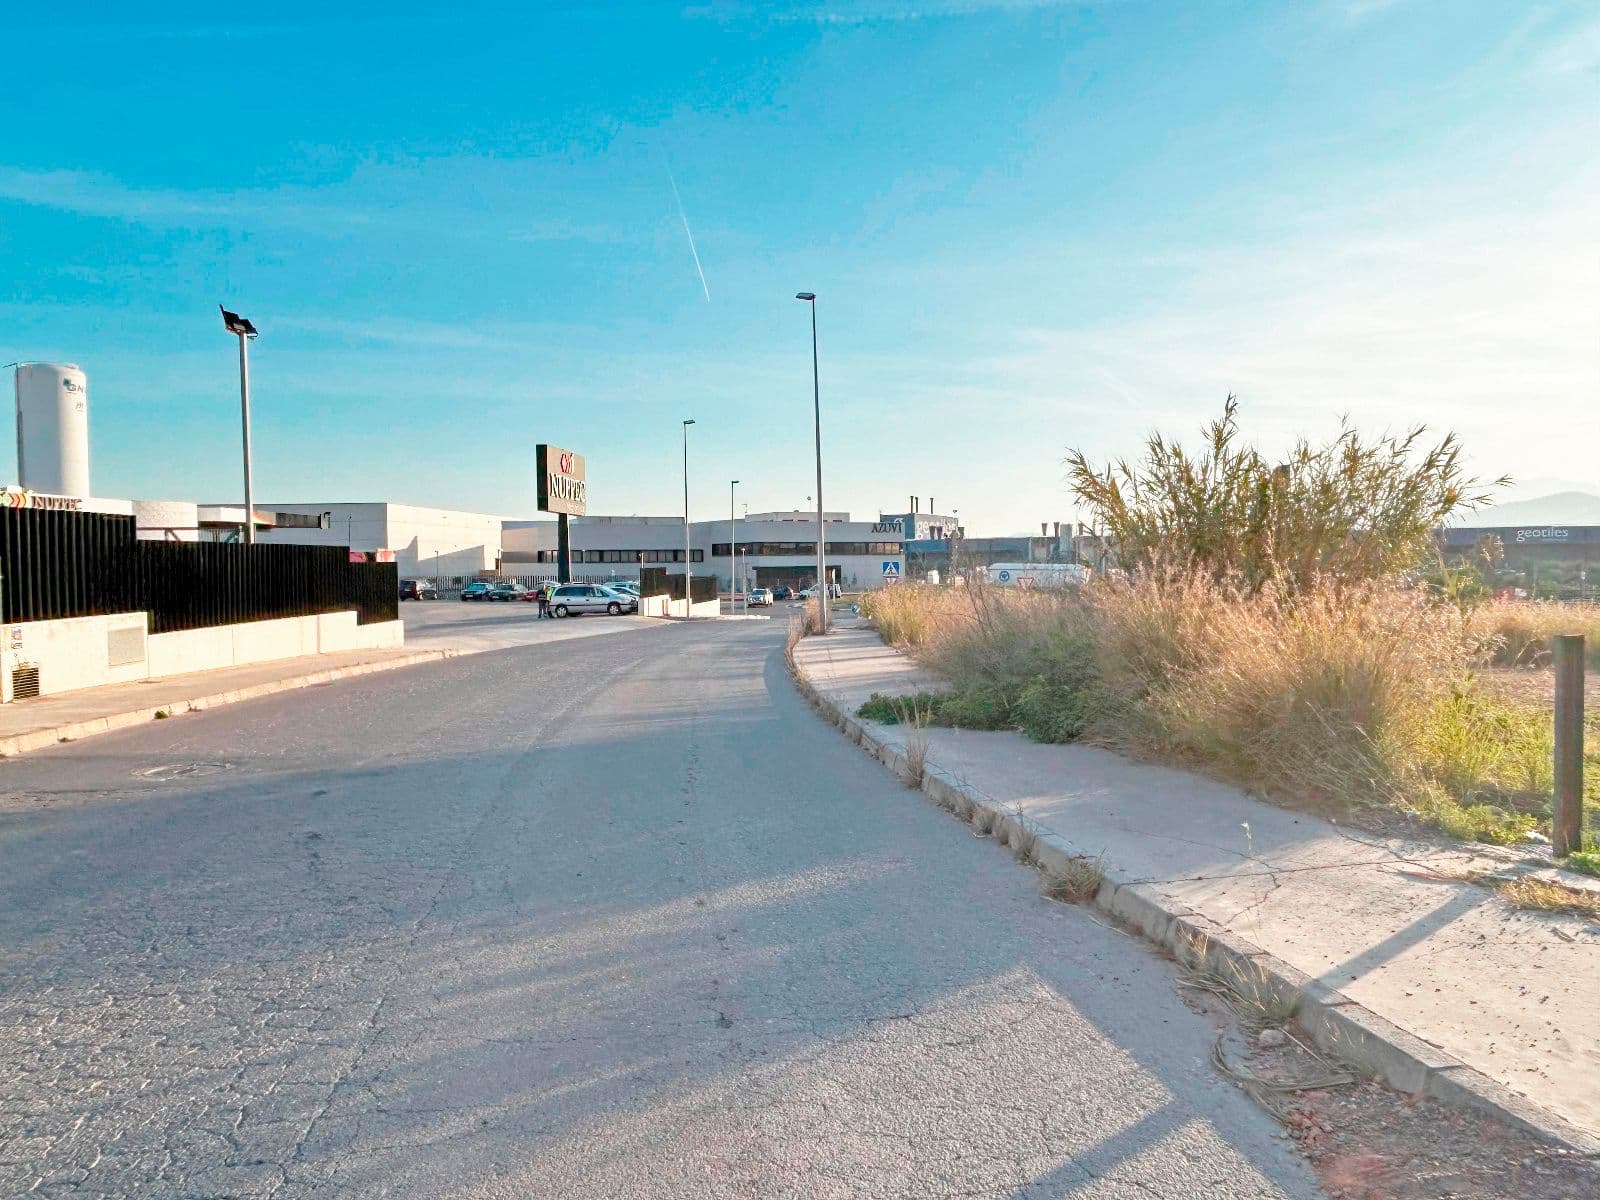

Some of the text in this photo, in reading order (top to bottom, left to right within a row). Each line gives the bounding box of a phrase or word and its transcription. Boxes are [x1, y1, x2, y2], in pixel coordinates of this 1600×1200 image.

[548, 472, 586, 502] NUPPEC
[871, 522, 902, 534] AZUVI
[1516, 527, 1569, 543] geotiles
